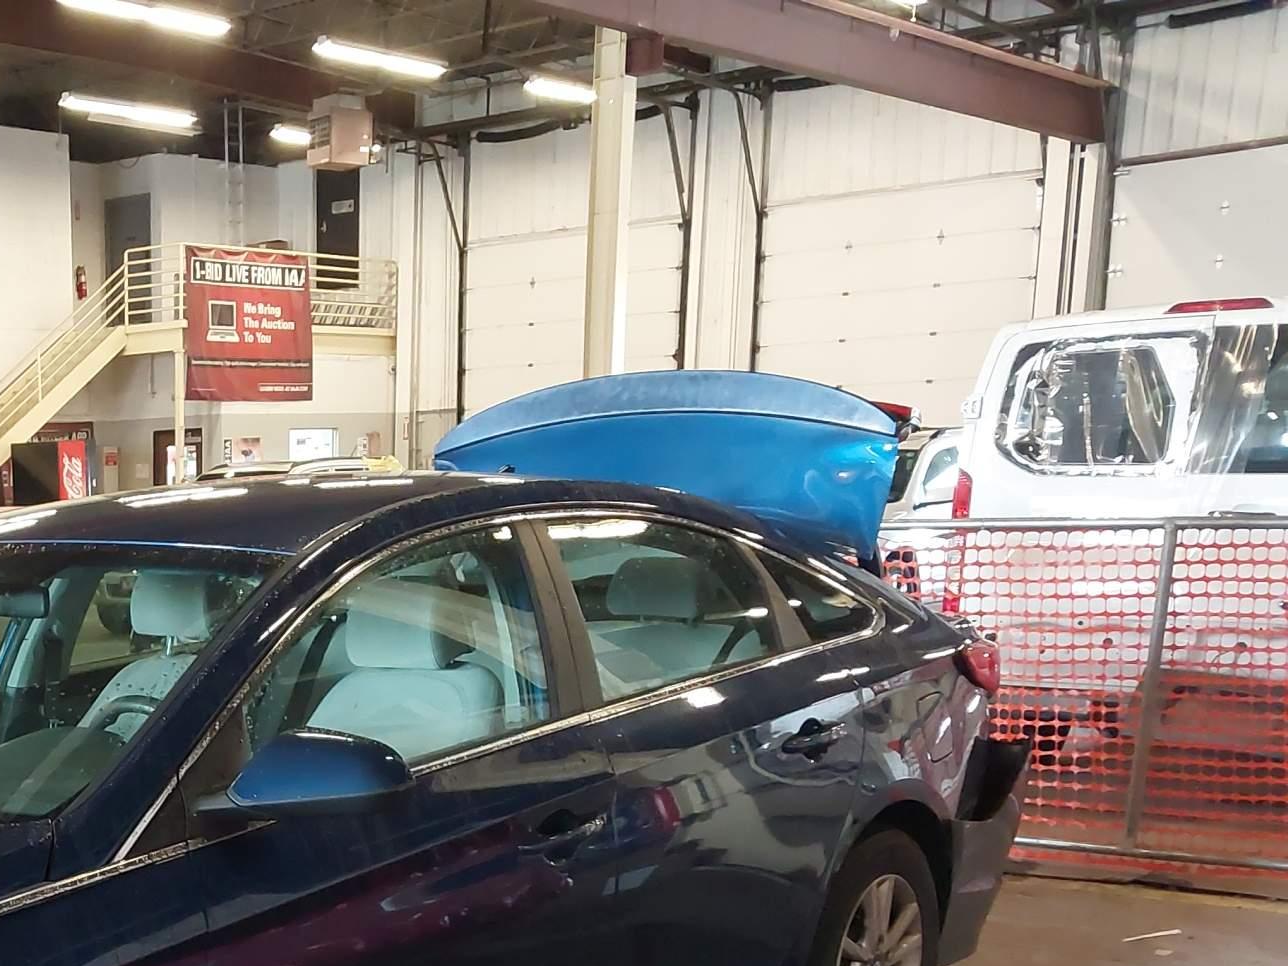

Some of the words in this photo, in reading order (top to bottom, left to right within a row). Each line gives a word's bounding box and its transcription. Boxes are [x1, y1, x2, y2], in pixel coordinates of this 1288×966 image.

[225, 263, 249, 283] LIVE
[251, 266, 282, 286] FROM
[243, 302, 256, 314] We
[257, 303, 282, 317] Bring
[243, 317, 259, 329] The
[261, 318, 296, 331] Auction
[243, 331, 254, 343] To
[256, 332, 272, 344] You
